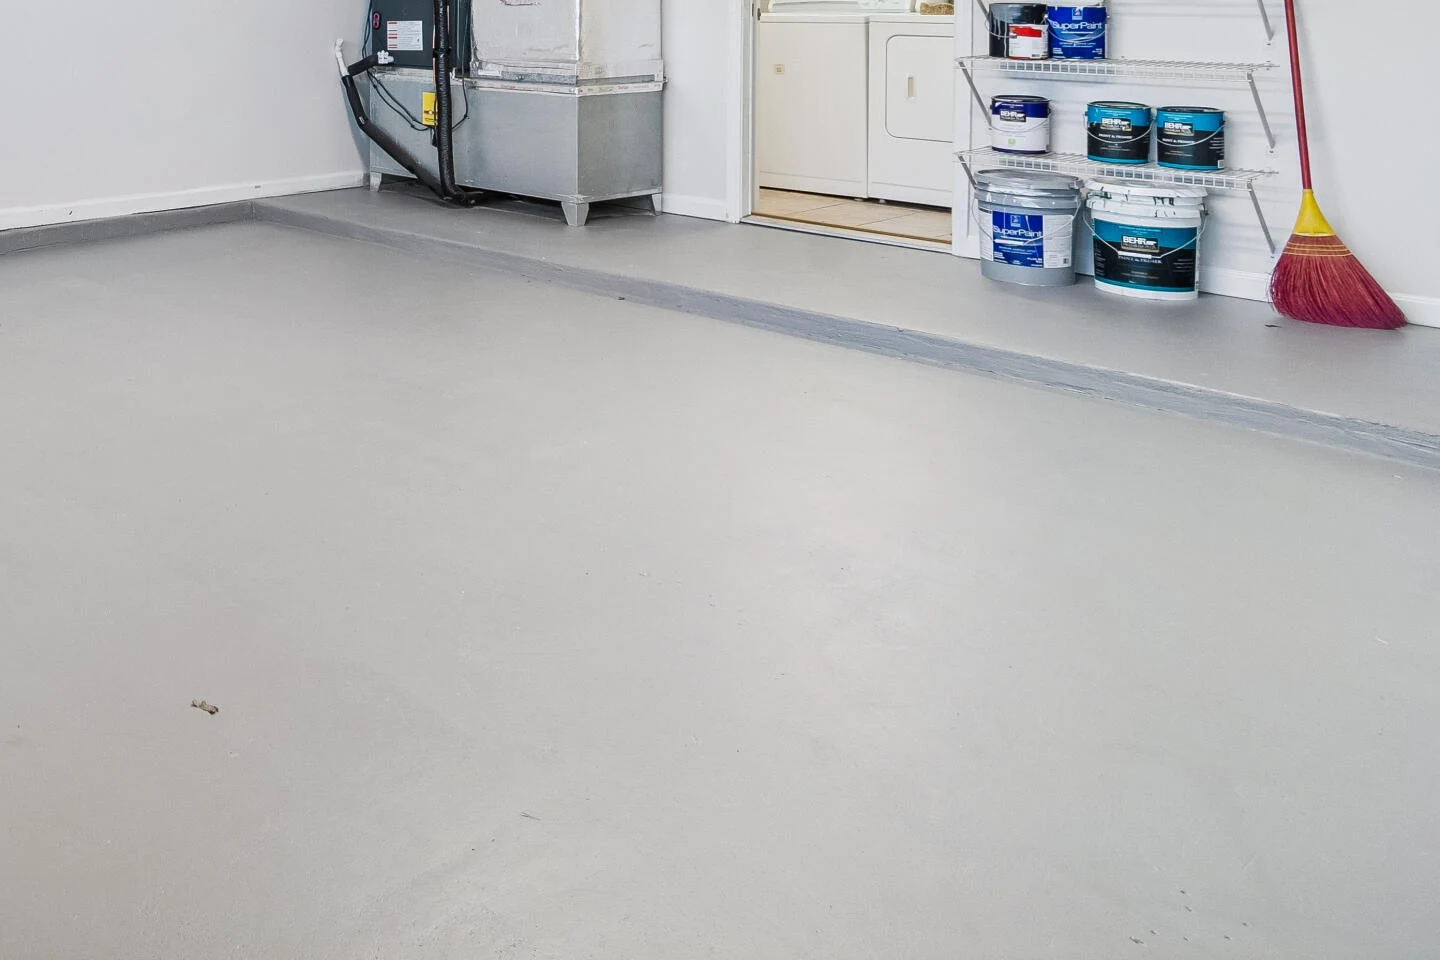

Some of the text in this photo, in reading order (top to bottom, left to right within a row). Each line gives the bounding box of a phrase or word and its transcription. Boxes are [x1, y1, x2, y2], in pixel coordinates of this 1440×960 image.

[1051, 21, 1102, 30] SuperPaint
[1101, 117, 1122, 125] BEHR
[1164, 121, 1183, 129] BEHR
[992, 224, 1042, 237] SuperPaint
[1122, 235, 1147, 244] BEHR
